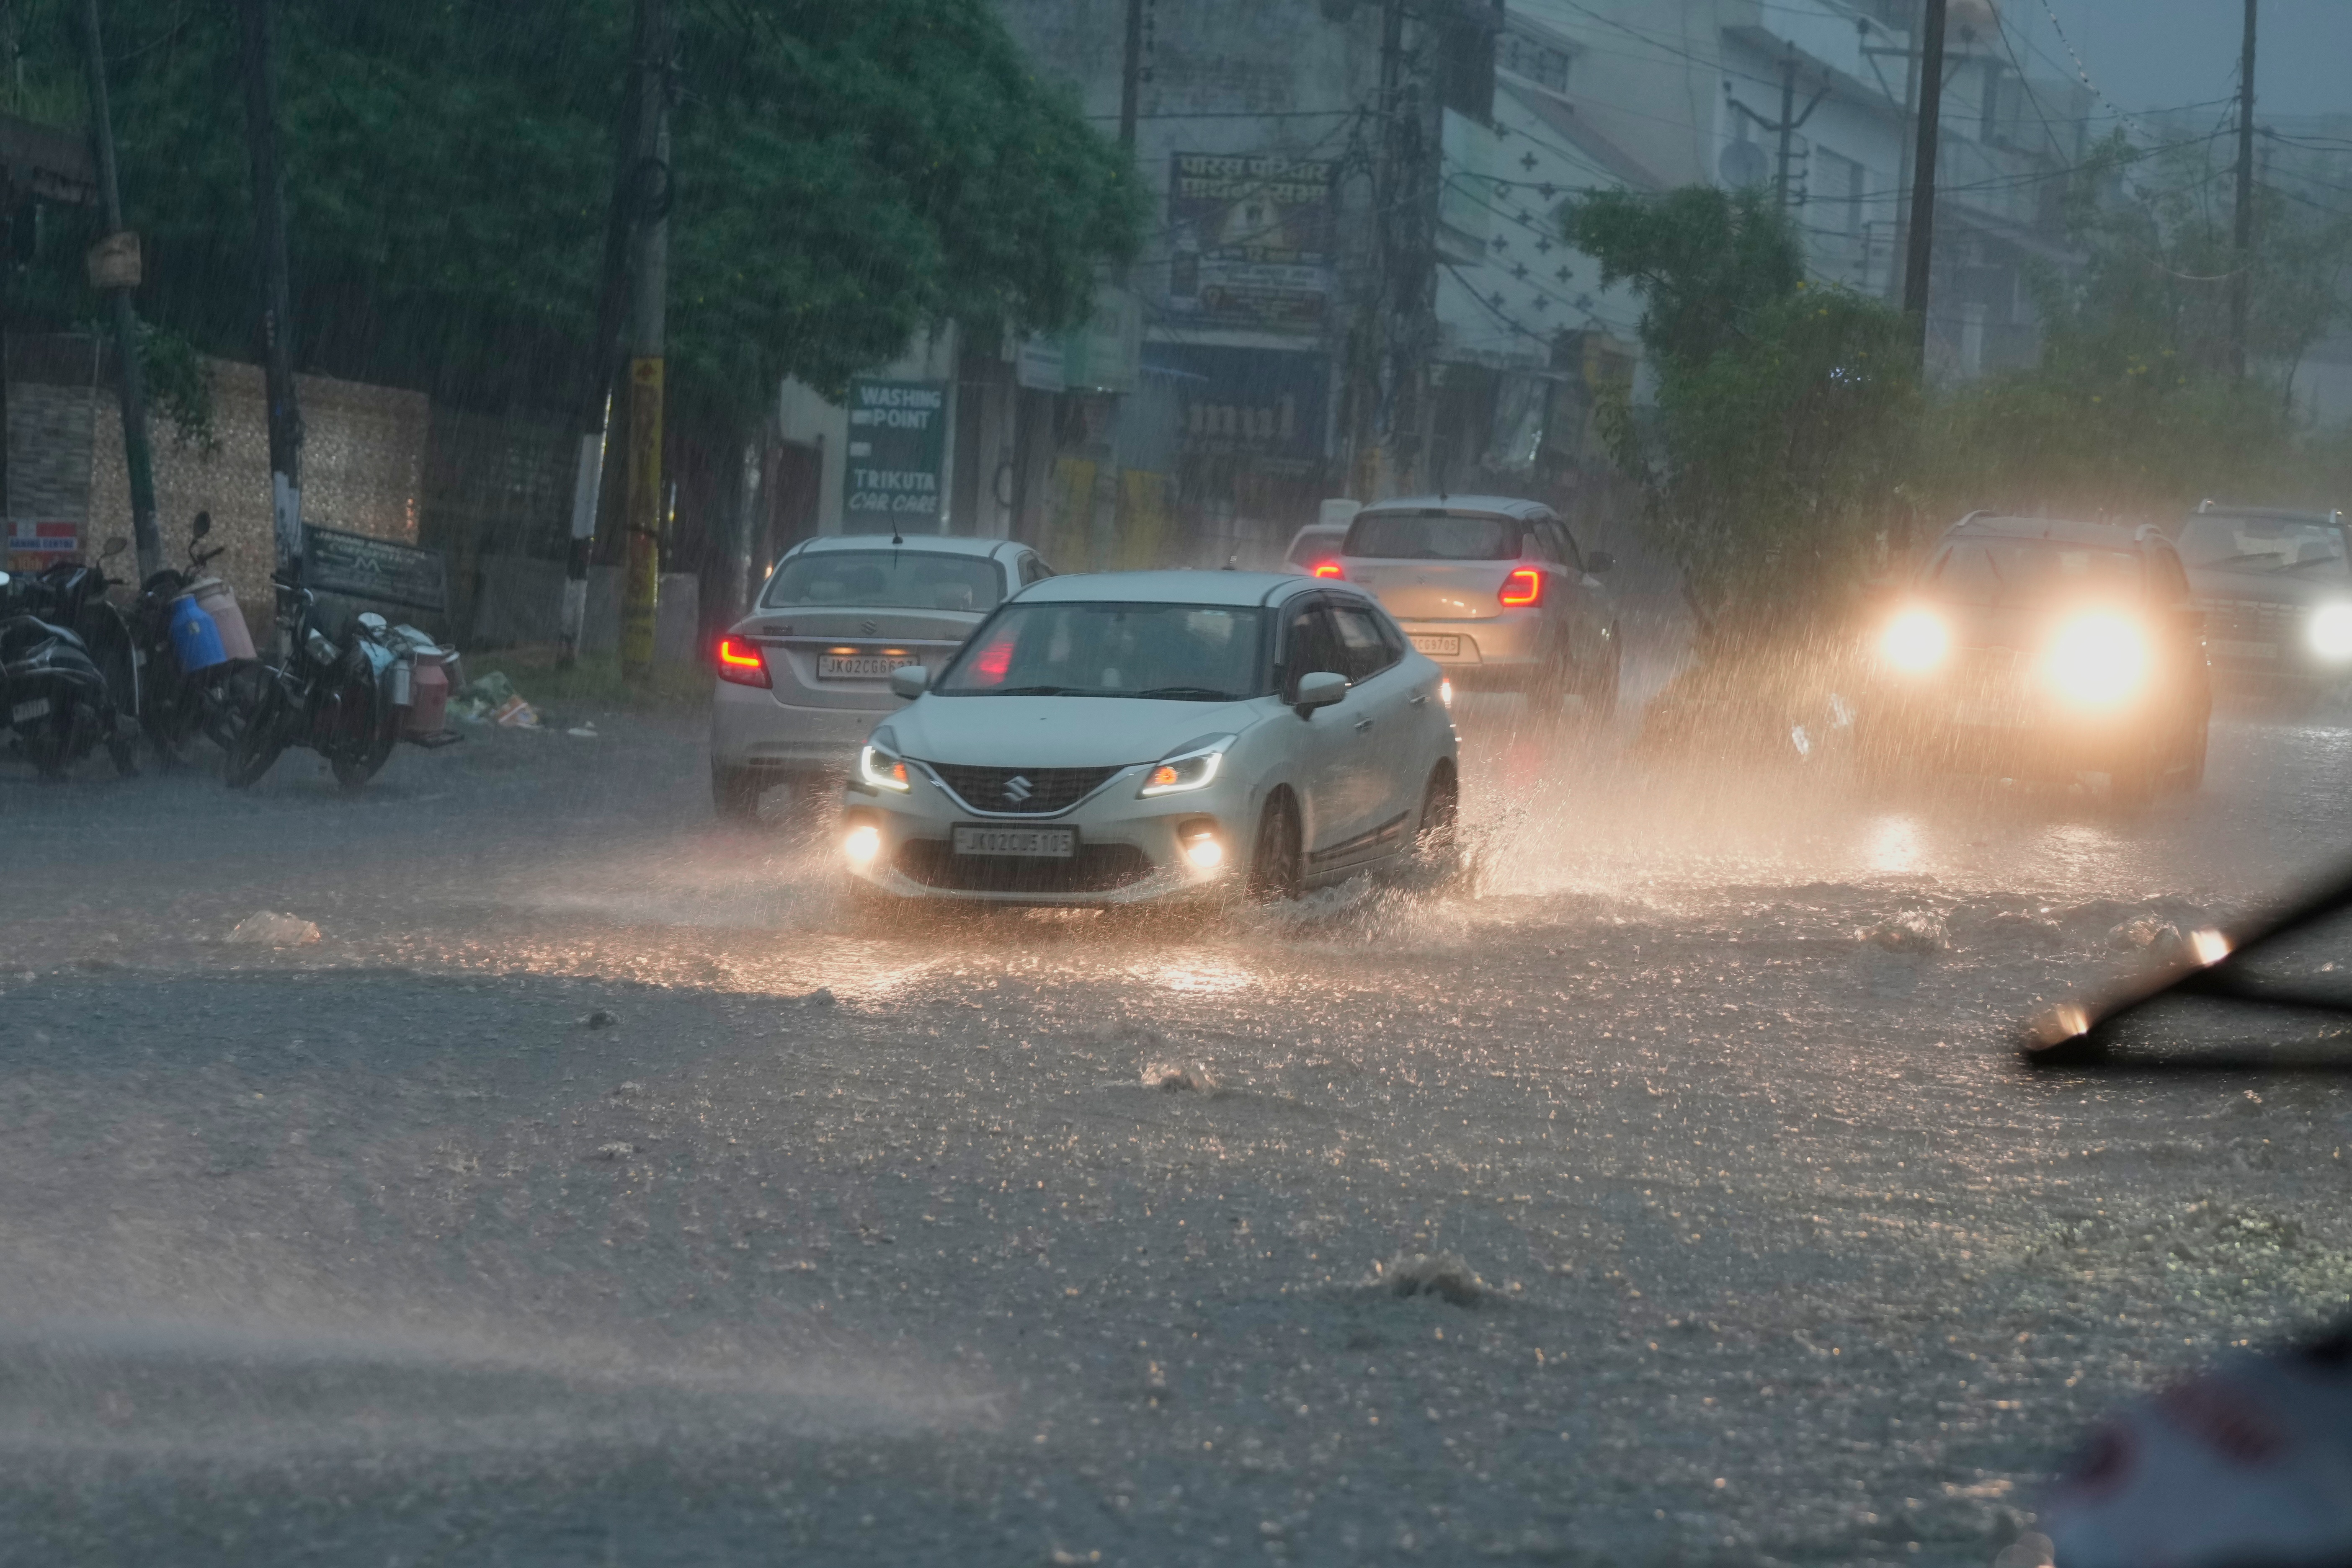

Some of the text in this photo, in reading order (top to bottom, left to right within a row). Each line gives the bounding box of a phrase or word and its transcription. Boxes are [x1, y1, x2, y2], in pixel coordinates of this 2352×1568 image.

[860, 386, 942, 408] WASHING
[874, 409, 931, 429] POINT
[854, 468, 935, 490] TRIKUTA
[850, 492, 937, 513] CAR CARE
